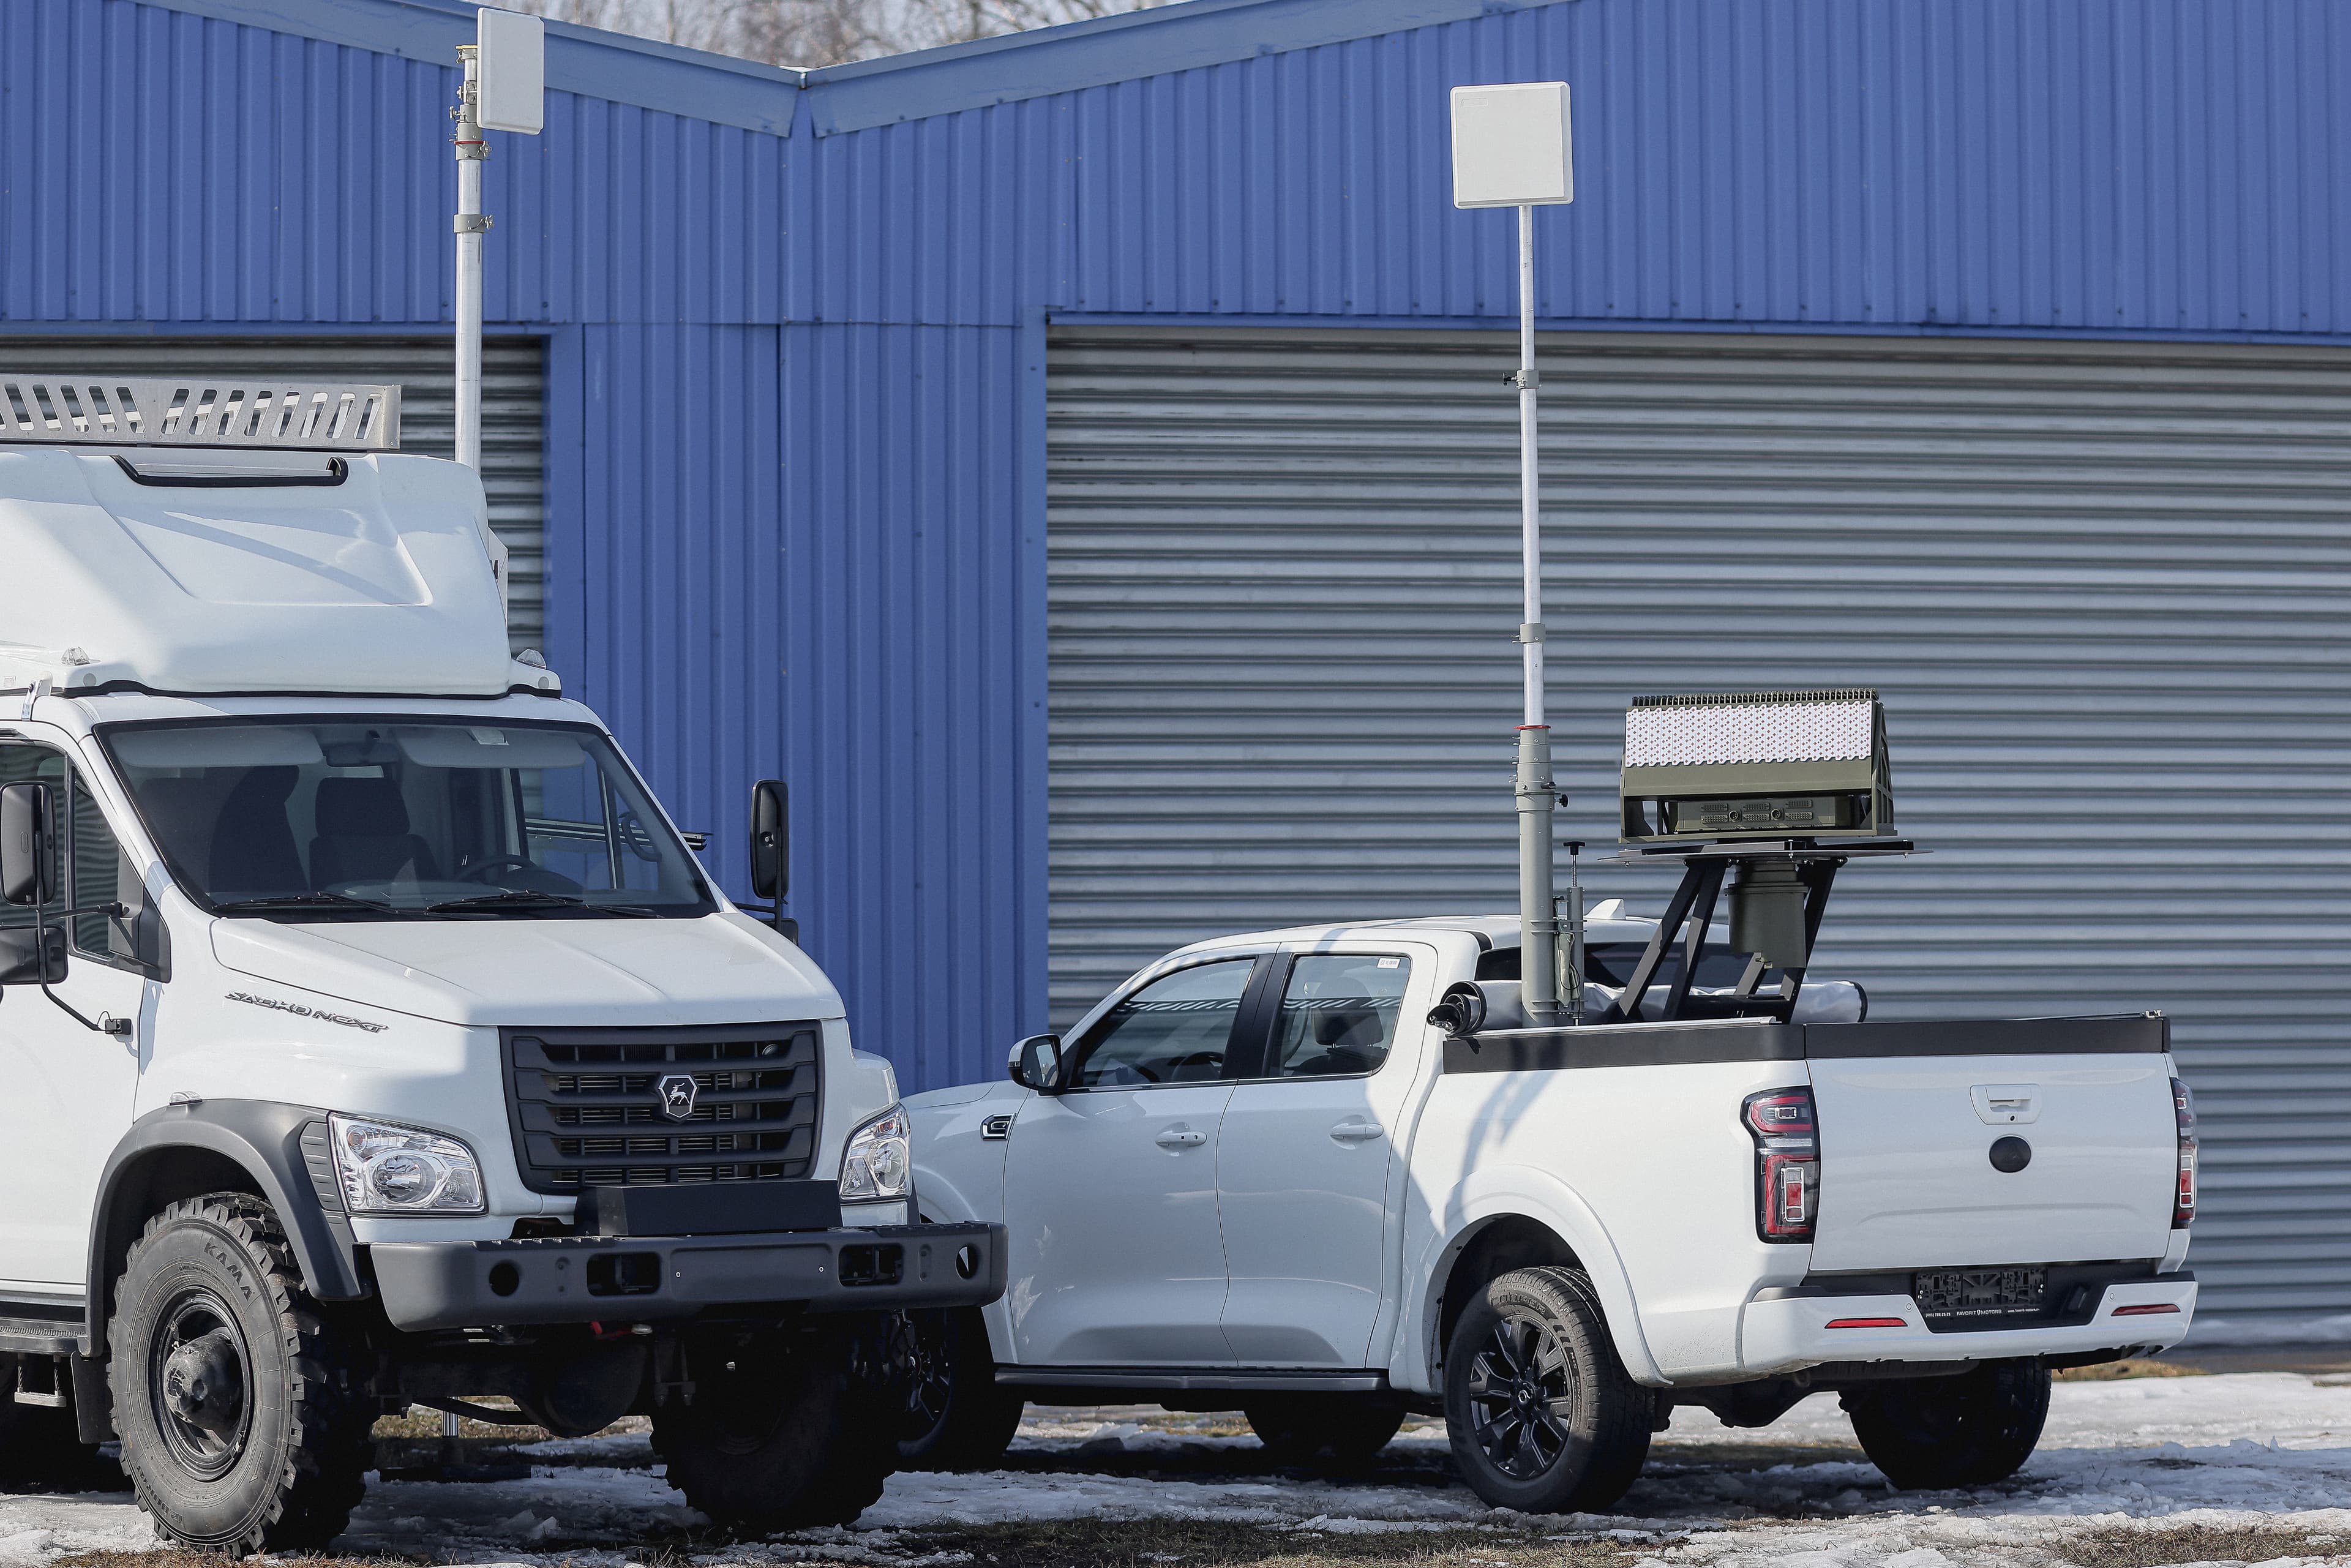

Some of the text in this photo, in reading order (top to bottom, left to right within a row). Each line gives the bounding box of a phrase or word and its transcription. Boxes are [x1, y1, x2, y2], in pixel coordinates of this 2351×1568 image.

[225, 989, 390, 1033] SADKO NEXT
[204, 1236, 252, 1302] KAMA
[1491, 1293, 1546, 1316] COOPER
